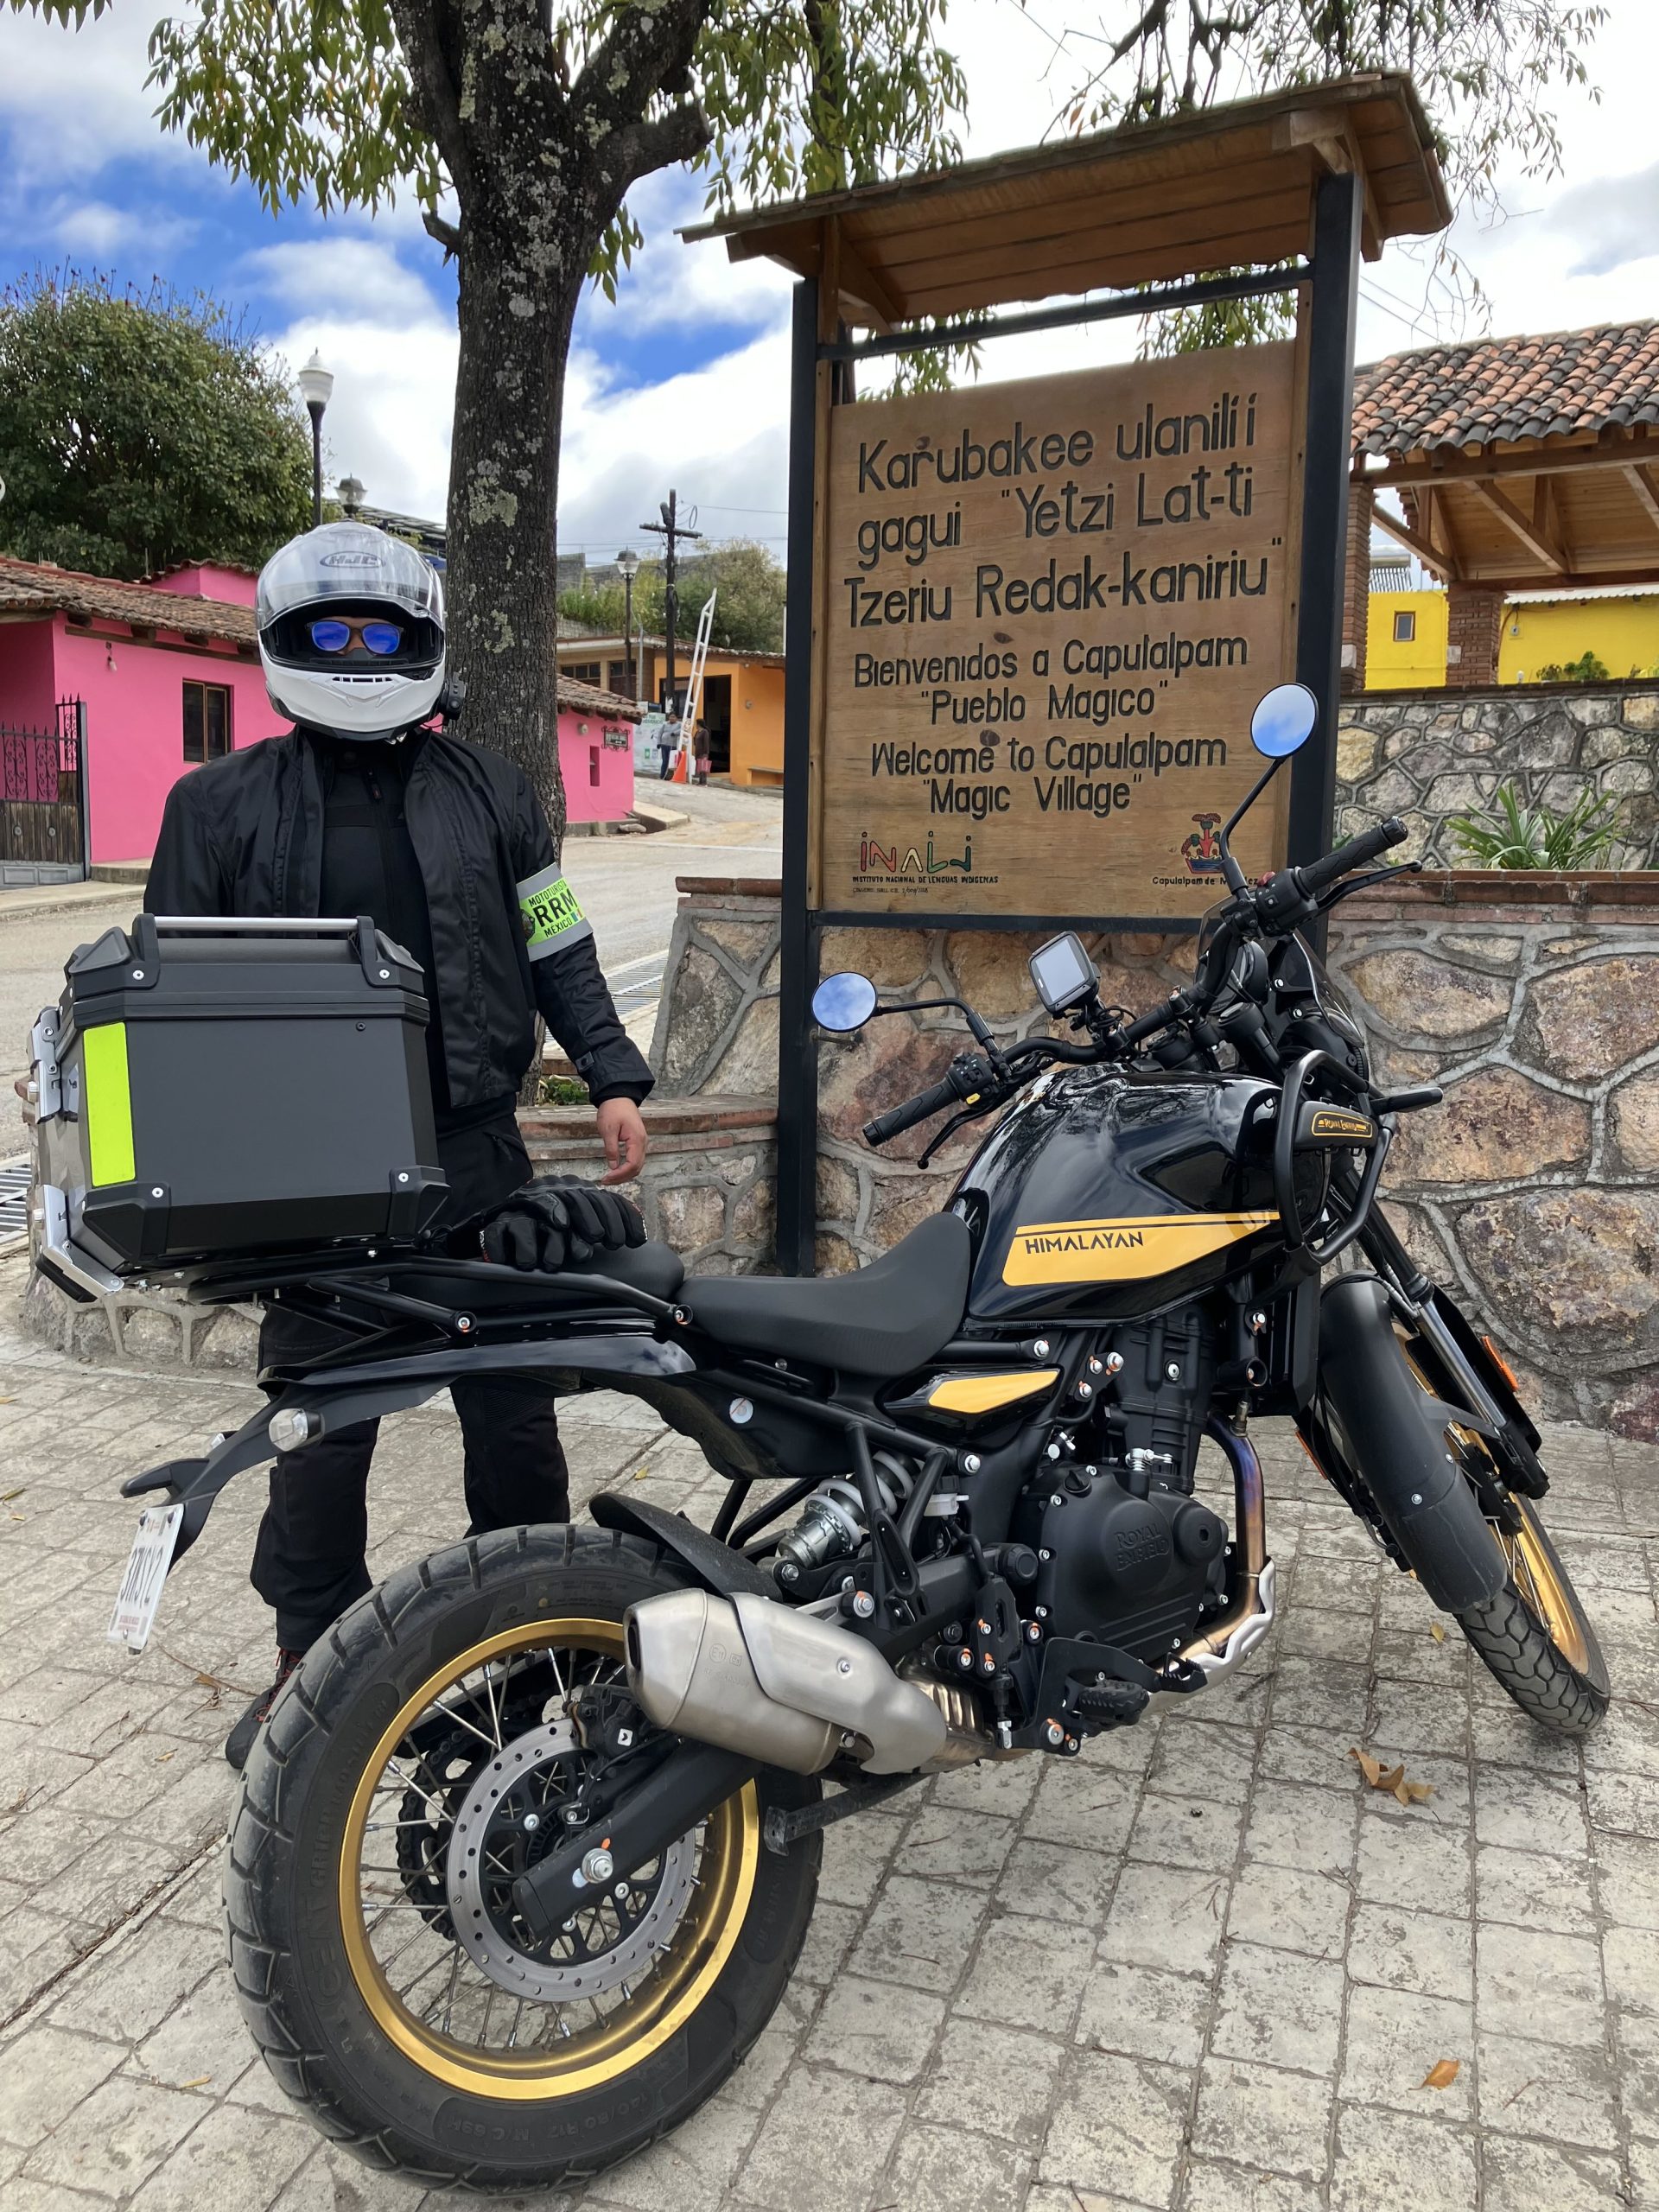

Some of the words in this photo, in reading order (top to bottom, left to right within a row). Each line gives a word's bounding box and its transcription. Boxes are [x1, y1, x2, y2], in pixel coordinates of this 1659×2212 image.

[859, 422, 1094, 493] Karubakee
[858, 501, 961, 571] gagui
[1138, 461, 1253, 527] Lat-ti
[327, 556, 378, 566] HJC
[844, 577, 951, 628] Tzeriu
[855, 643, 1018, 688] Bienvenidos
[1033, 650, 1049, 677] a
[1064, 632, 1248, 680] Capulalpam
[921, 687, 1026, 725] "Pueblo
[872, 742, 995, 777] Welcome
[1007, 737, 1035, 772] to
[1046, 731, 1227, 779] Capulalpam
[923, 778, 1011, 821] "Magic
[1033, 772, 1142, 818] Village"
[1152, 876, 1204, 887] Capulalpam
[1205, 876, 1215, 885] de
[532, 887, 578, 927] RRM
[543, 917, 572, 938] MEXICO
[1025, 1231, 1143, 1255] HIMALAYAN
